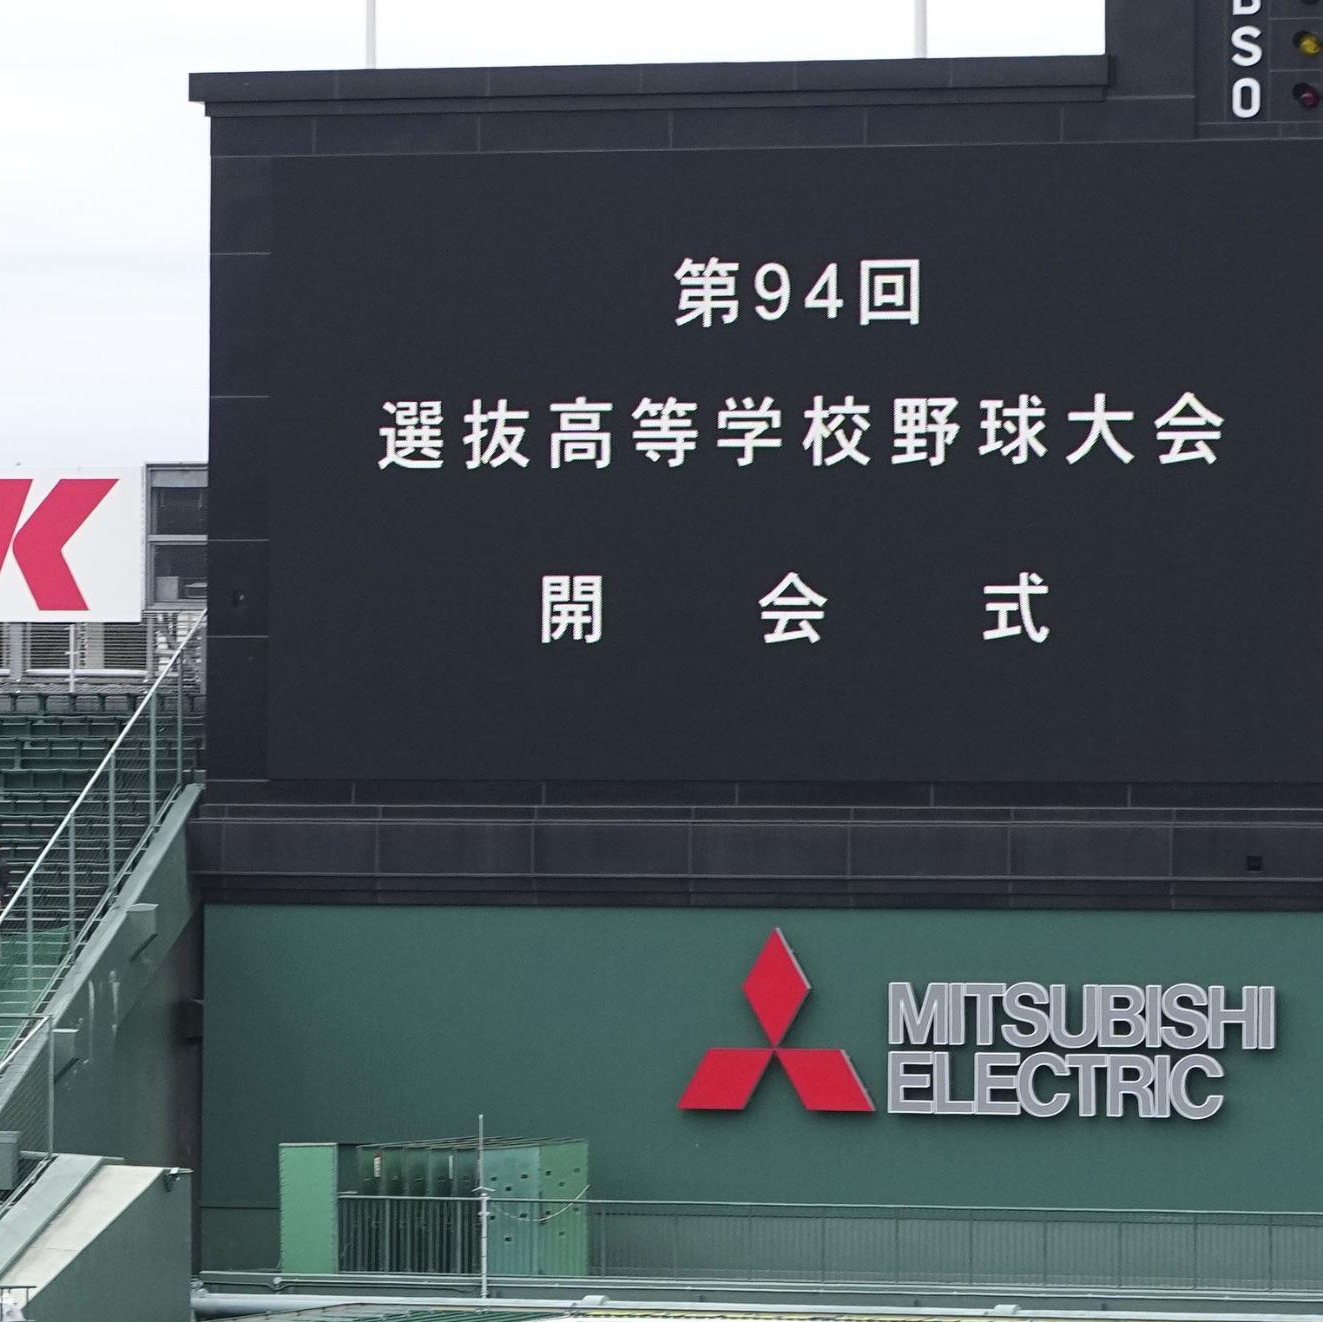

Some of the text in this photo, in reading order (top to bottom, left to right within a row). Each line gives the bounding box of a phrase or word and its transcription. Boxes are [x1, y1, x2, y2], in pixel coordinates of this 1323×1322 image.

[672, 255, 923, 328] 第94回
[376, 390, 1227, 471] 選抜高等学校野球大会
[887, 981, 1276, 1050] MITSUBISHI
[887, 1050, 1225, 1119] ELECTRIC
